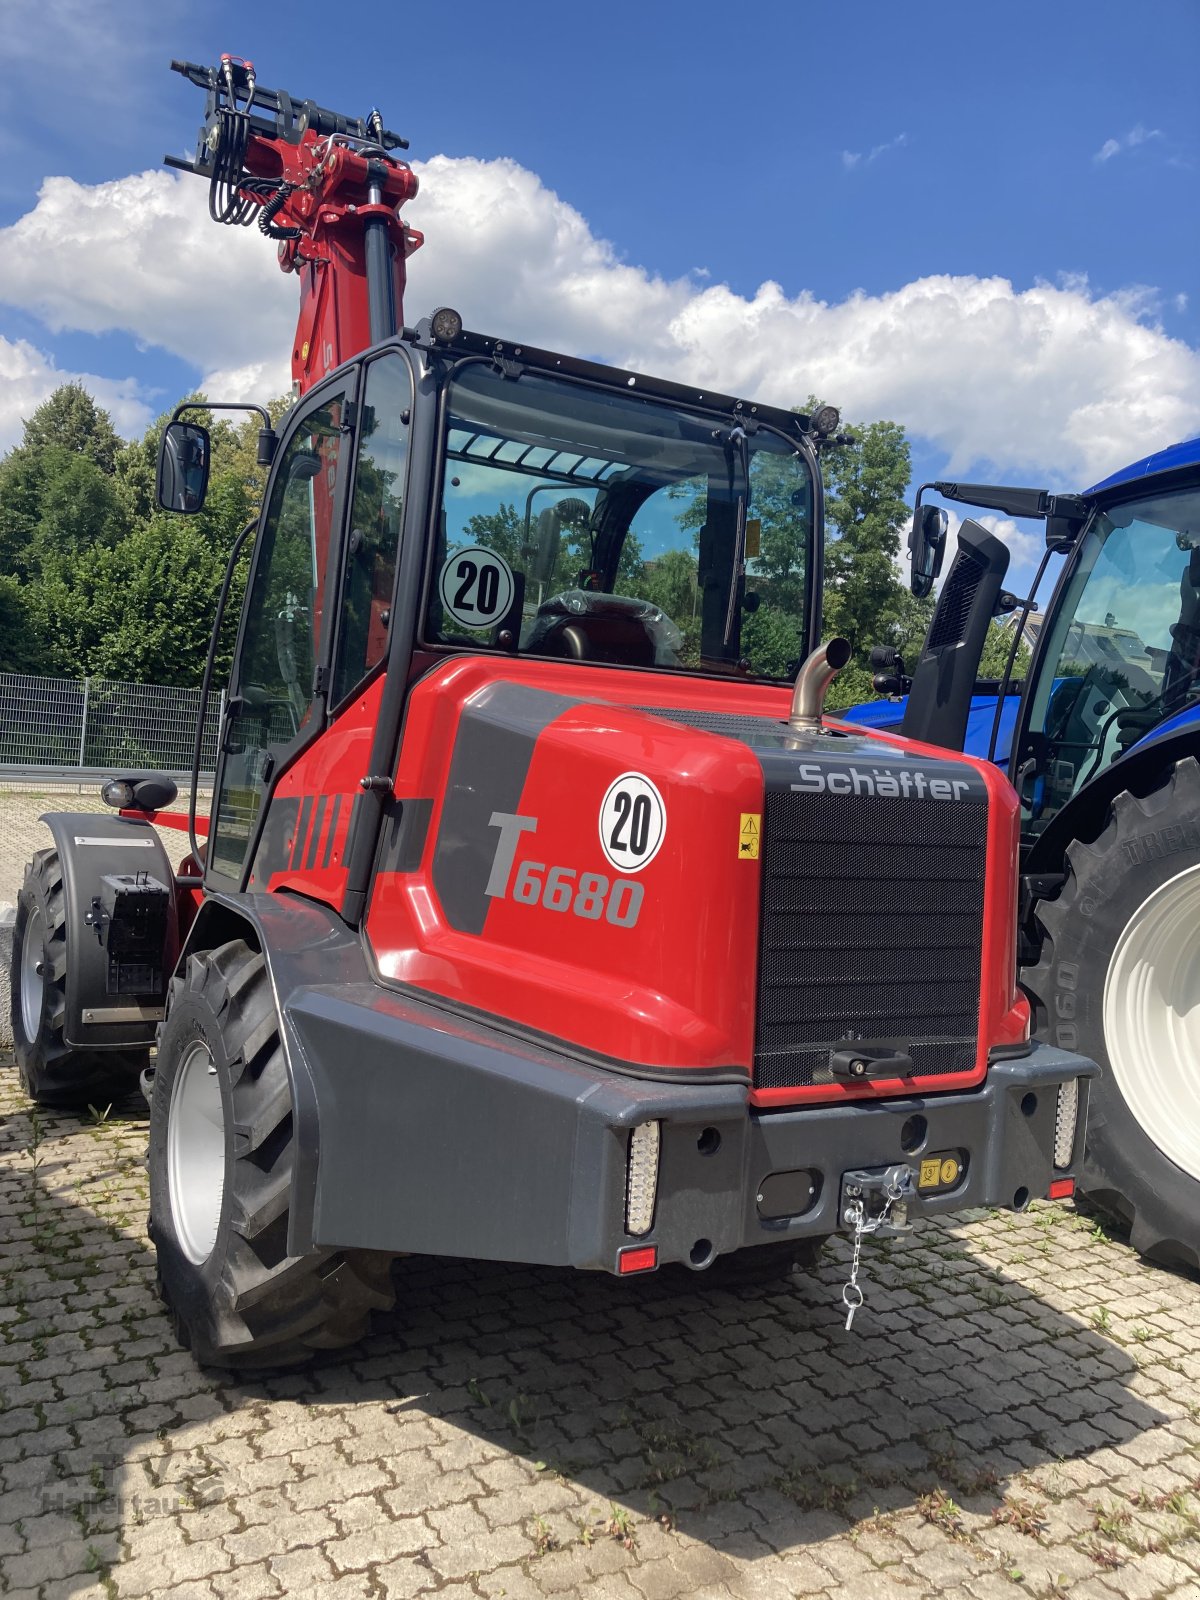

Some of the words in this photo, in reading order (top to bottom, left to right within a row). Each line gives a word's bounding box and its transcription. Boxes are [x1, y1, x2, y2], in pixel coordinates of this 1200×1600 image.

[453, 560, 500, 615] 20
[790, 764, 970, 801] Schäffer
[609, 790, 652, 856] 20
[484, 811, 645, 929] T6680
